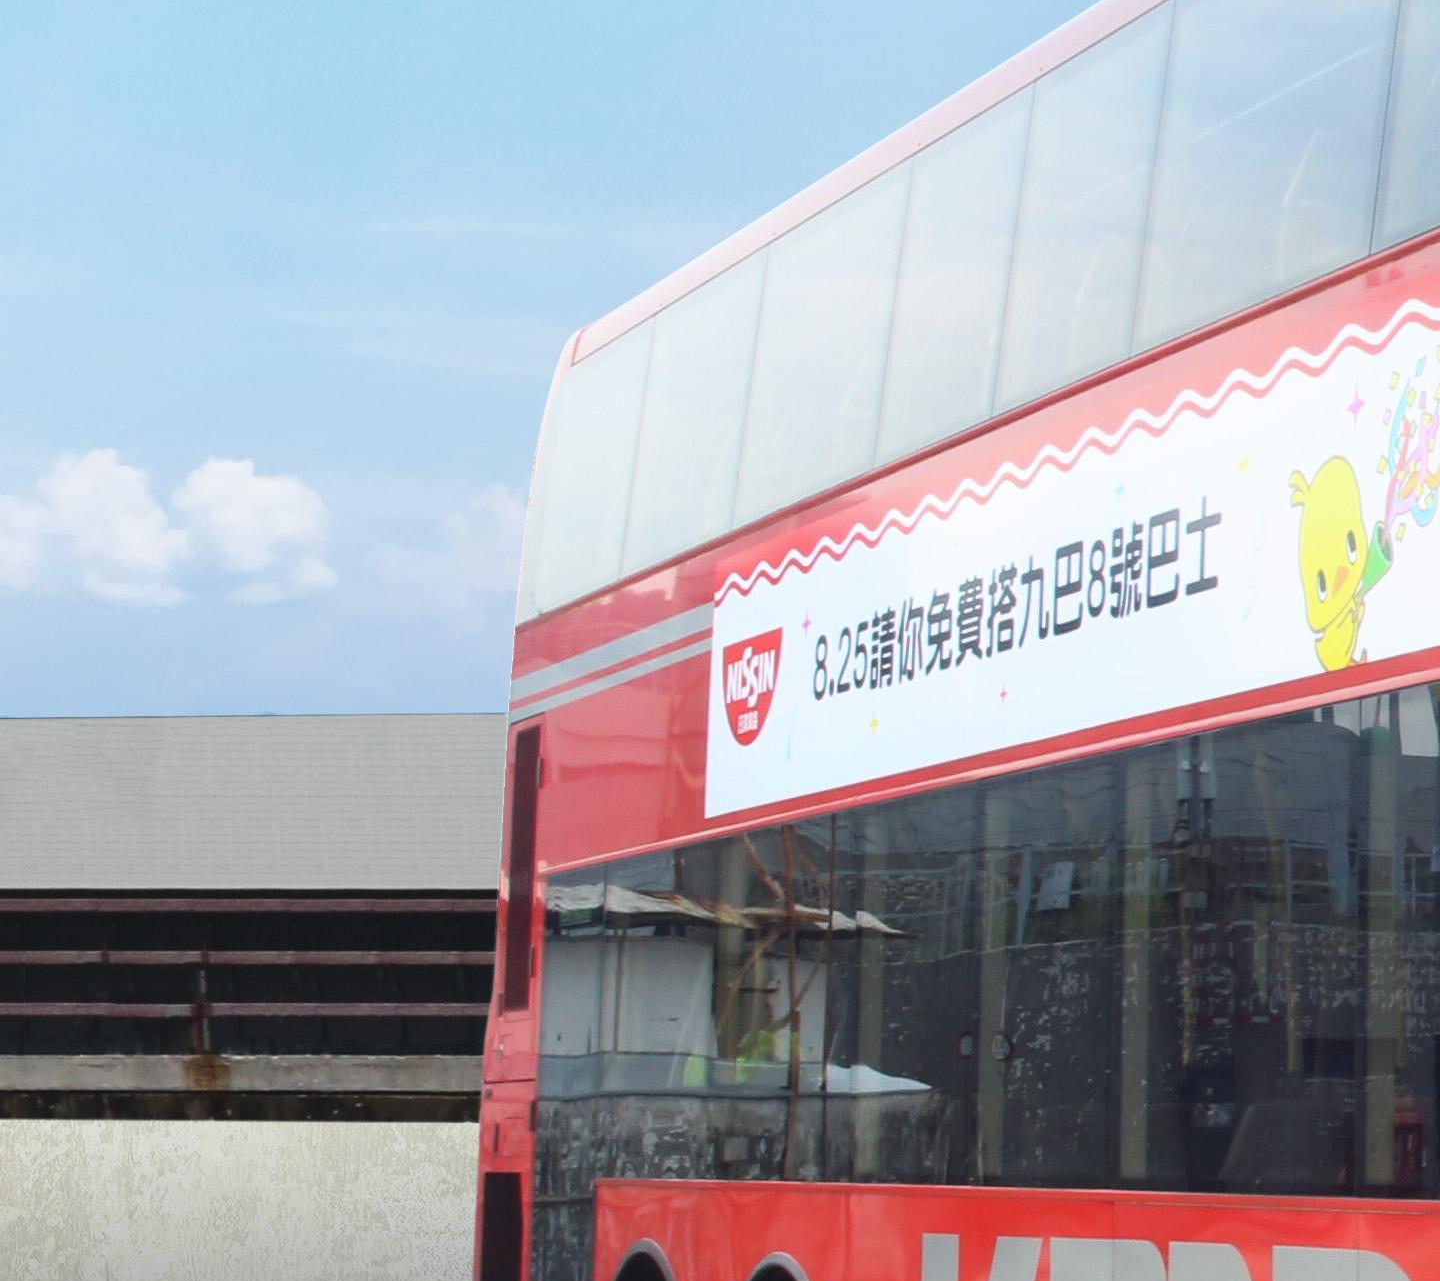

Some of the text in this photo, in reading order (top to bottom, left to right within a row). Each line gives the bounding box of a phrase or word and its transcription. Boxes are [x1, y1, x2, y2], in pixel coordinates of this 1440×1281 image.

[812, 495, 1222, 701] 8.25請你免費搭九巴8號巴士
[726, 645, 777, 709] NISSIN
